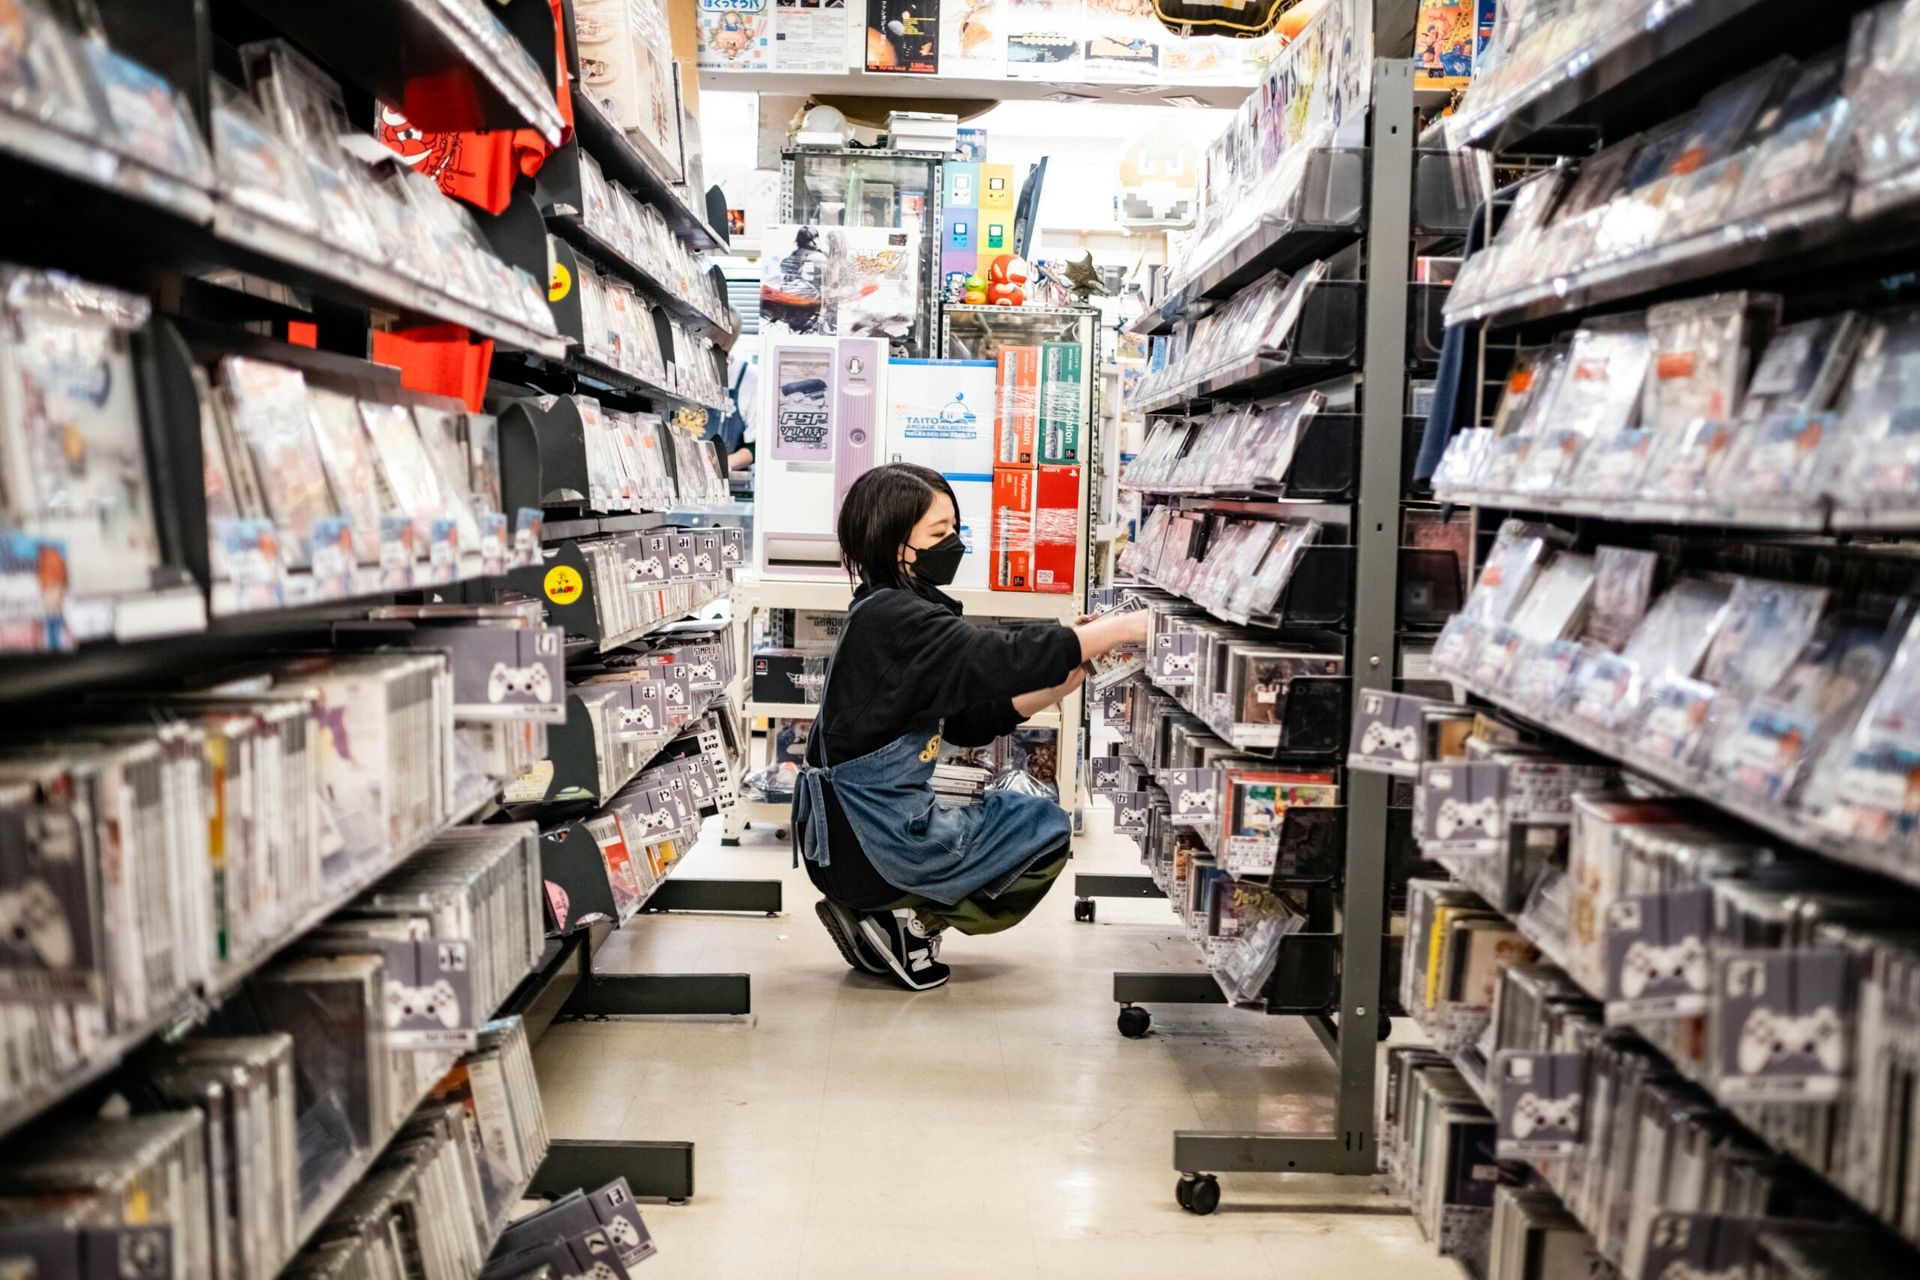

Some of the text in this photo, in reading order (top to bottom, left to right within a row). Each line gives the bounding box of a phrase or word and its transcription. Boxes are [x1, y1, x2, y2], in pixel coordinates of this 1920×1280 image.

[781, 412, 828, 425] PSP
[1020, 473, 1028, 509] PlayStation
[652, 538, 663, 550] ま
[679, 538, 689, 547] み
[693, 646, 717, 655] SIMPLE
[675, 667, 685, 677] も
[643, 687, 654, 698] む
[1175, 773, 1184, 784] く
[659, 791, 670, 801] や
